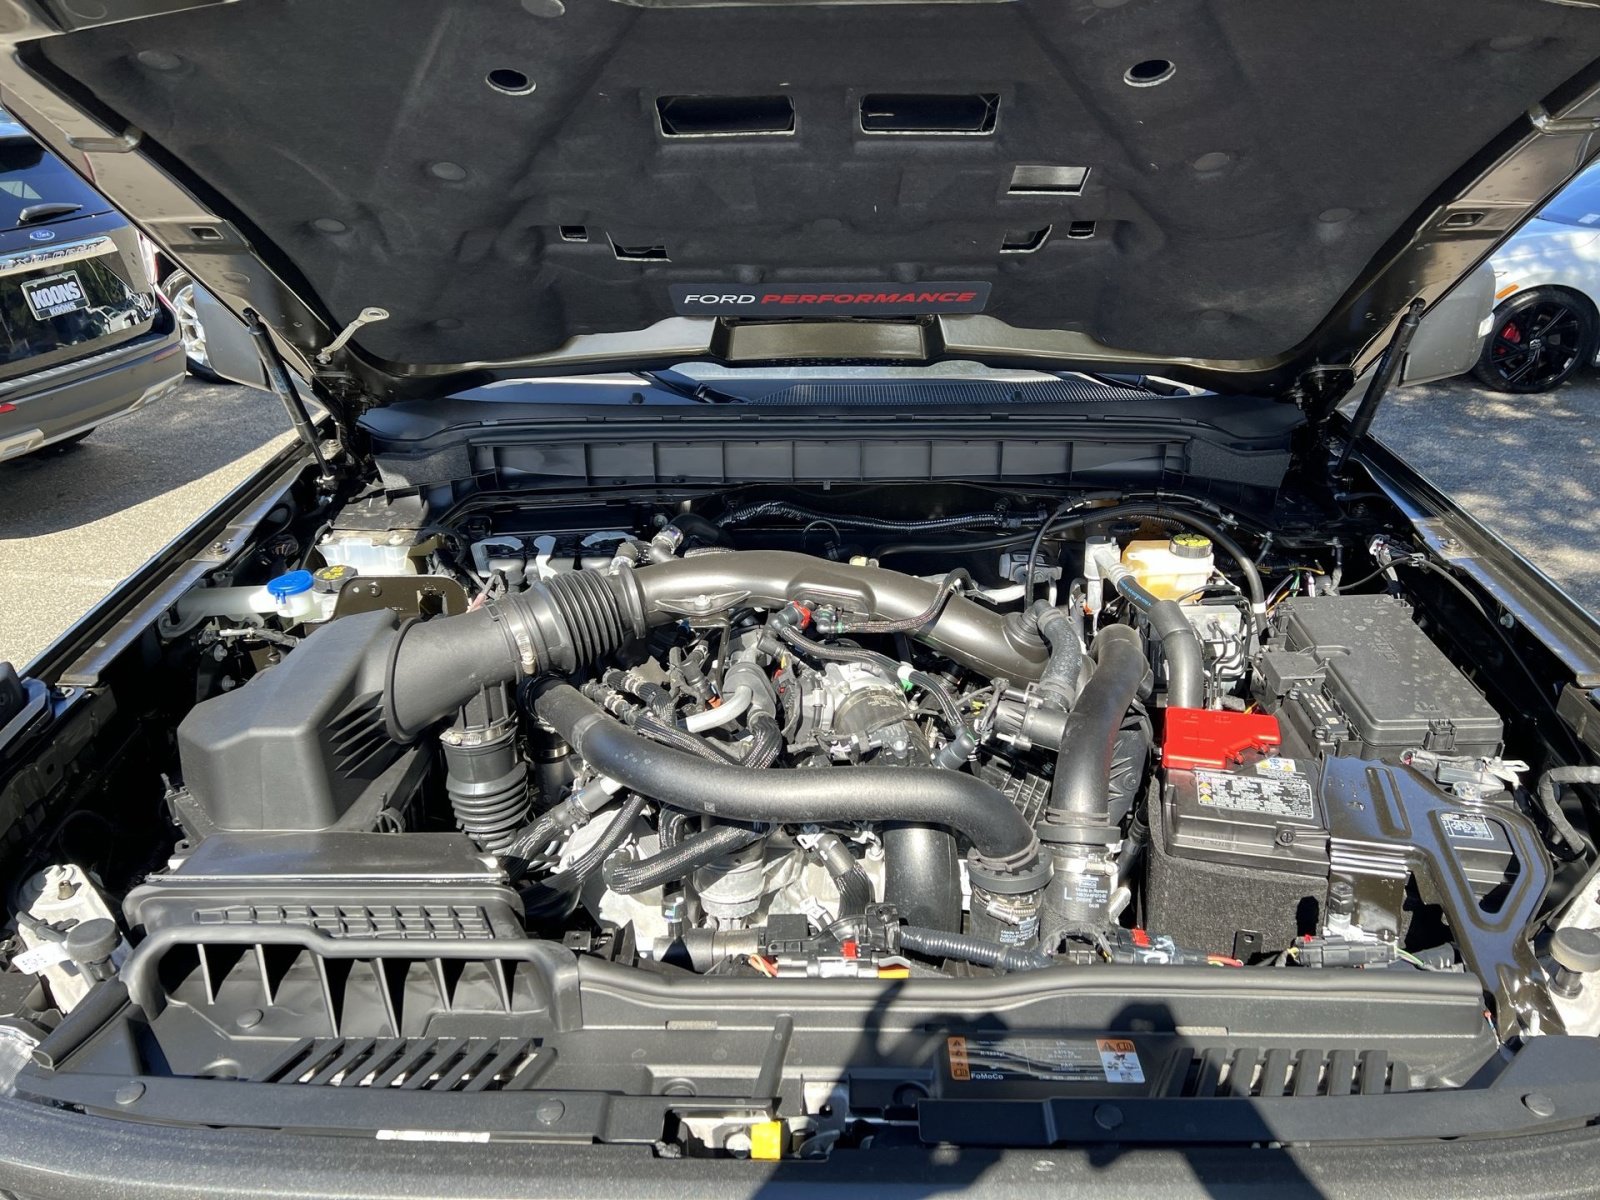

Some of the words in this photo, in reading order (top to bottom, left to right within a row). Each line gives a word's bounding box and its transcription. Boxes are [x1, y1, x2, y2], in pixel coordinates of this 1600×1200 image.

[30, 282, 81, 309] KOONS
[684, 294, 756, 305] FORD
[761, 292, 977, 305] PERFORMANCE
[49, 302, 77, 316] KOONS
[971, 1073, 1004, 1081] FoMoCo
